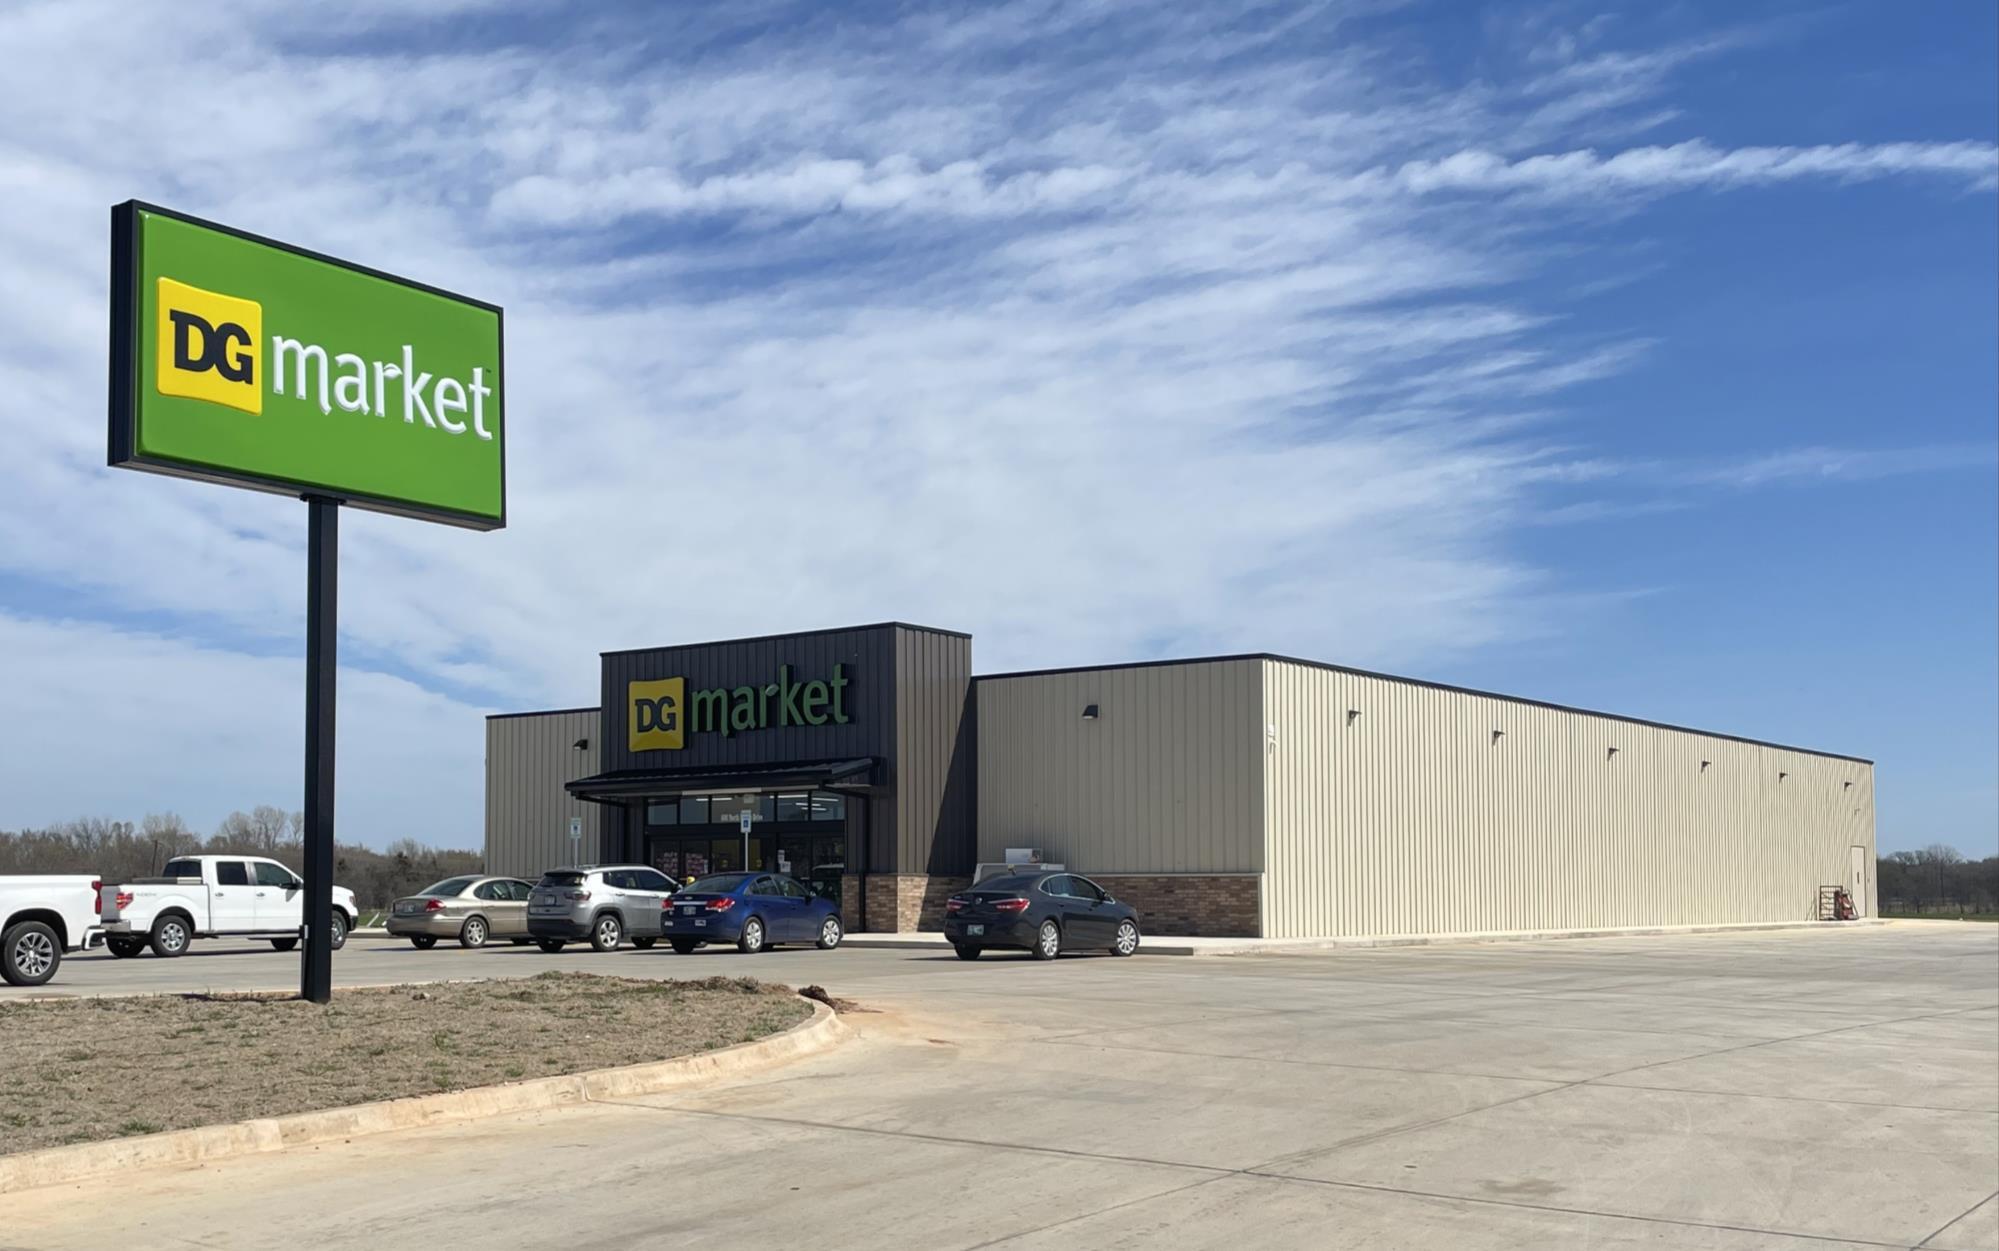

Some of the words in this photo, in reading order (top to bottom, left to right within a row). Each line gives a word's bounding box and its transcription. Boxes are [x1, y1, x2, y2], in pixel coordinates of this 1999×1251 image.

[169, 308, 254, 386] DG
[271, 335, 493, 440] market
[634, 695, 677, 733] DG
[691, 662, 849, 737] market
